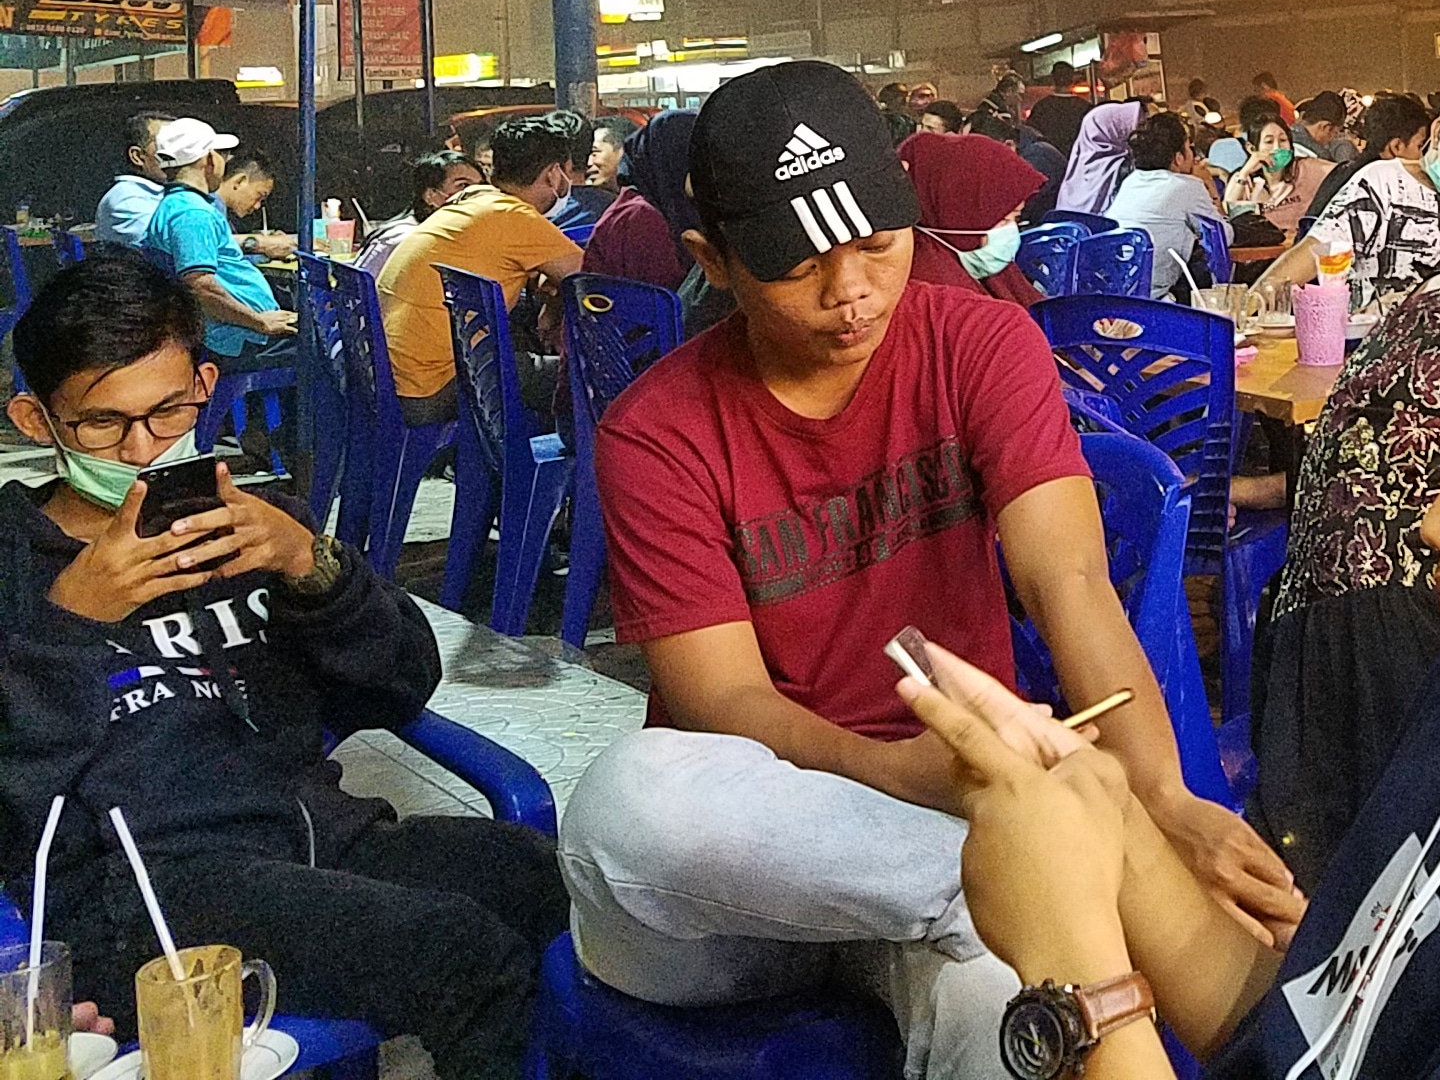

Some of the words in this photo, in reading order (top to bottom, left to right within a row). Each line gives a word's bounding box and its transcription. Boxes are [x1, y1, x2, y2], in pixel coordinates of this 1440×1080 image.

[774, 146, 846, 181] adidas
[736, 512, 810, 579] SAN
[105, 587, 271, 660] RIS
